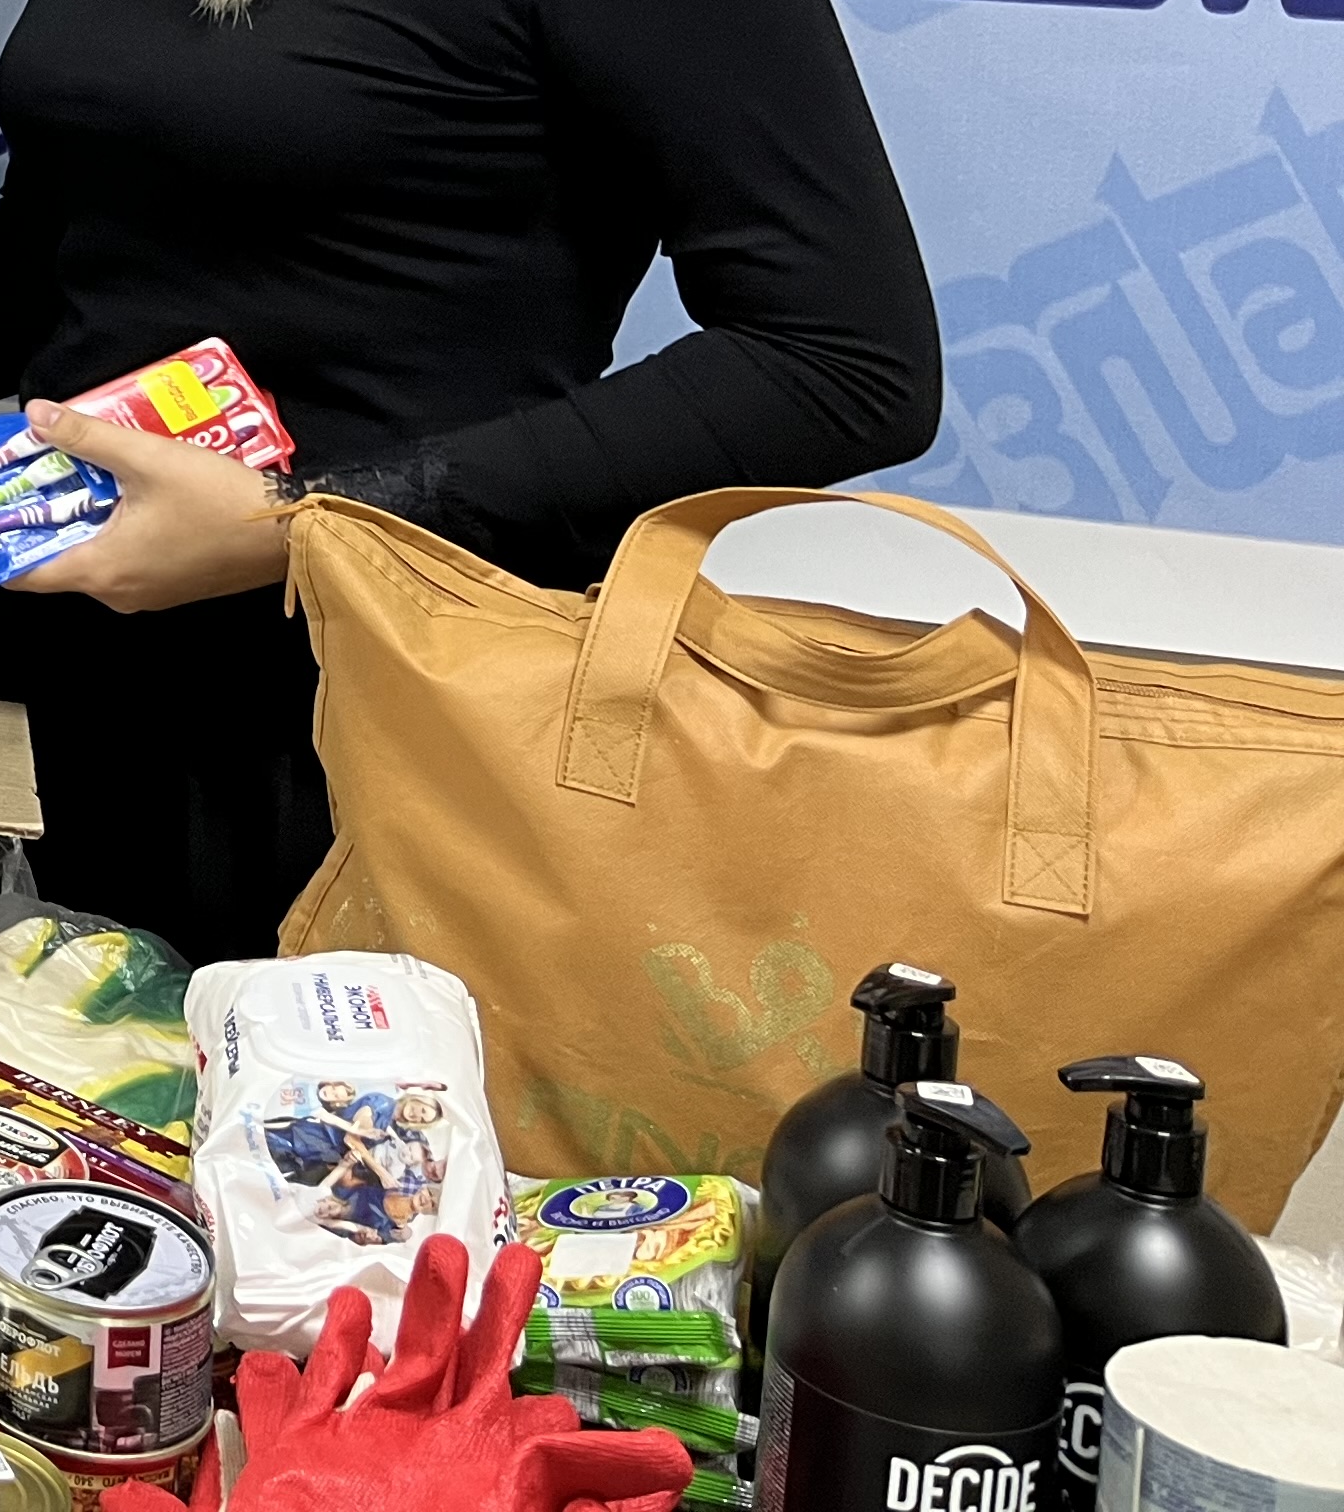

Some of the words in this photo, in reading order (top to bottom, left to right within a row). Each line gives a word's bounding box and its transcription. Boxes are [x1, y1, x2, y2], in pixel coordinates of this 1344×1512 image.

[6, 1194, 66, 1216] СПАСИБО,
[67, 1193, 95, 1204] ЧТО
[173, 1229, 206, 1276] КАЧЕСТВО
[886, 1455, 1041, 1512] DECIDE
